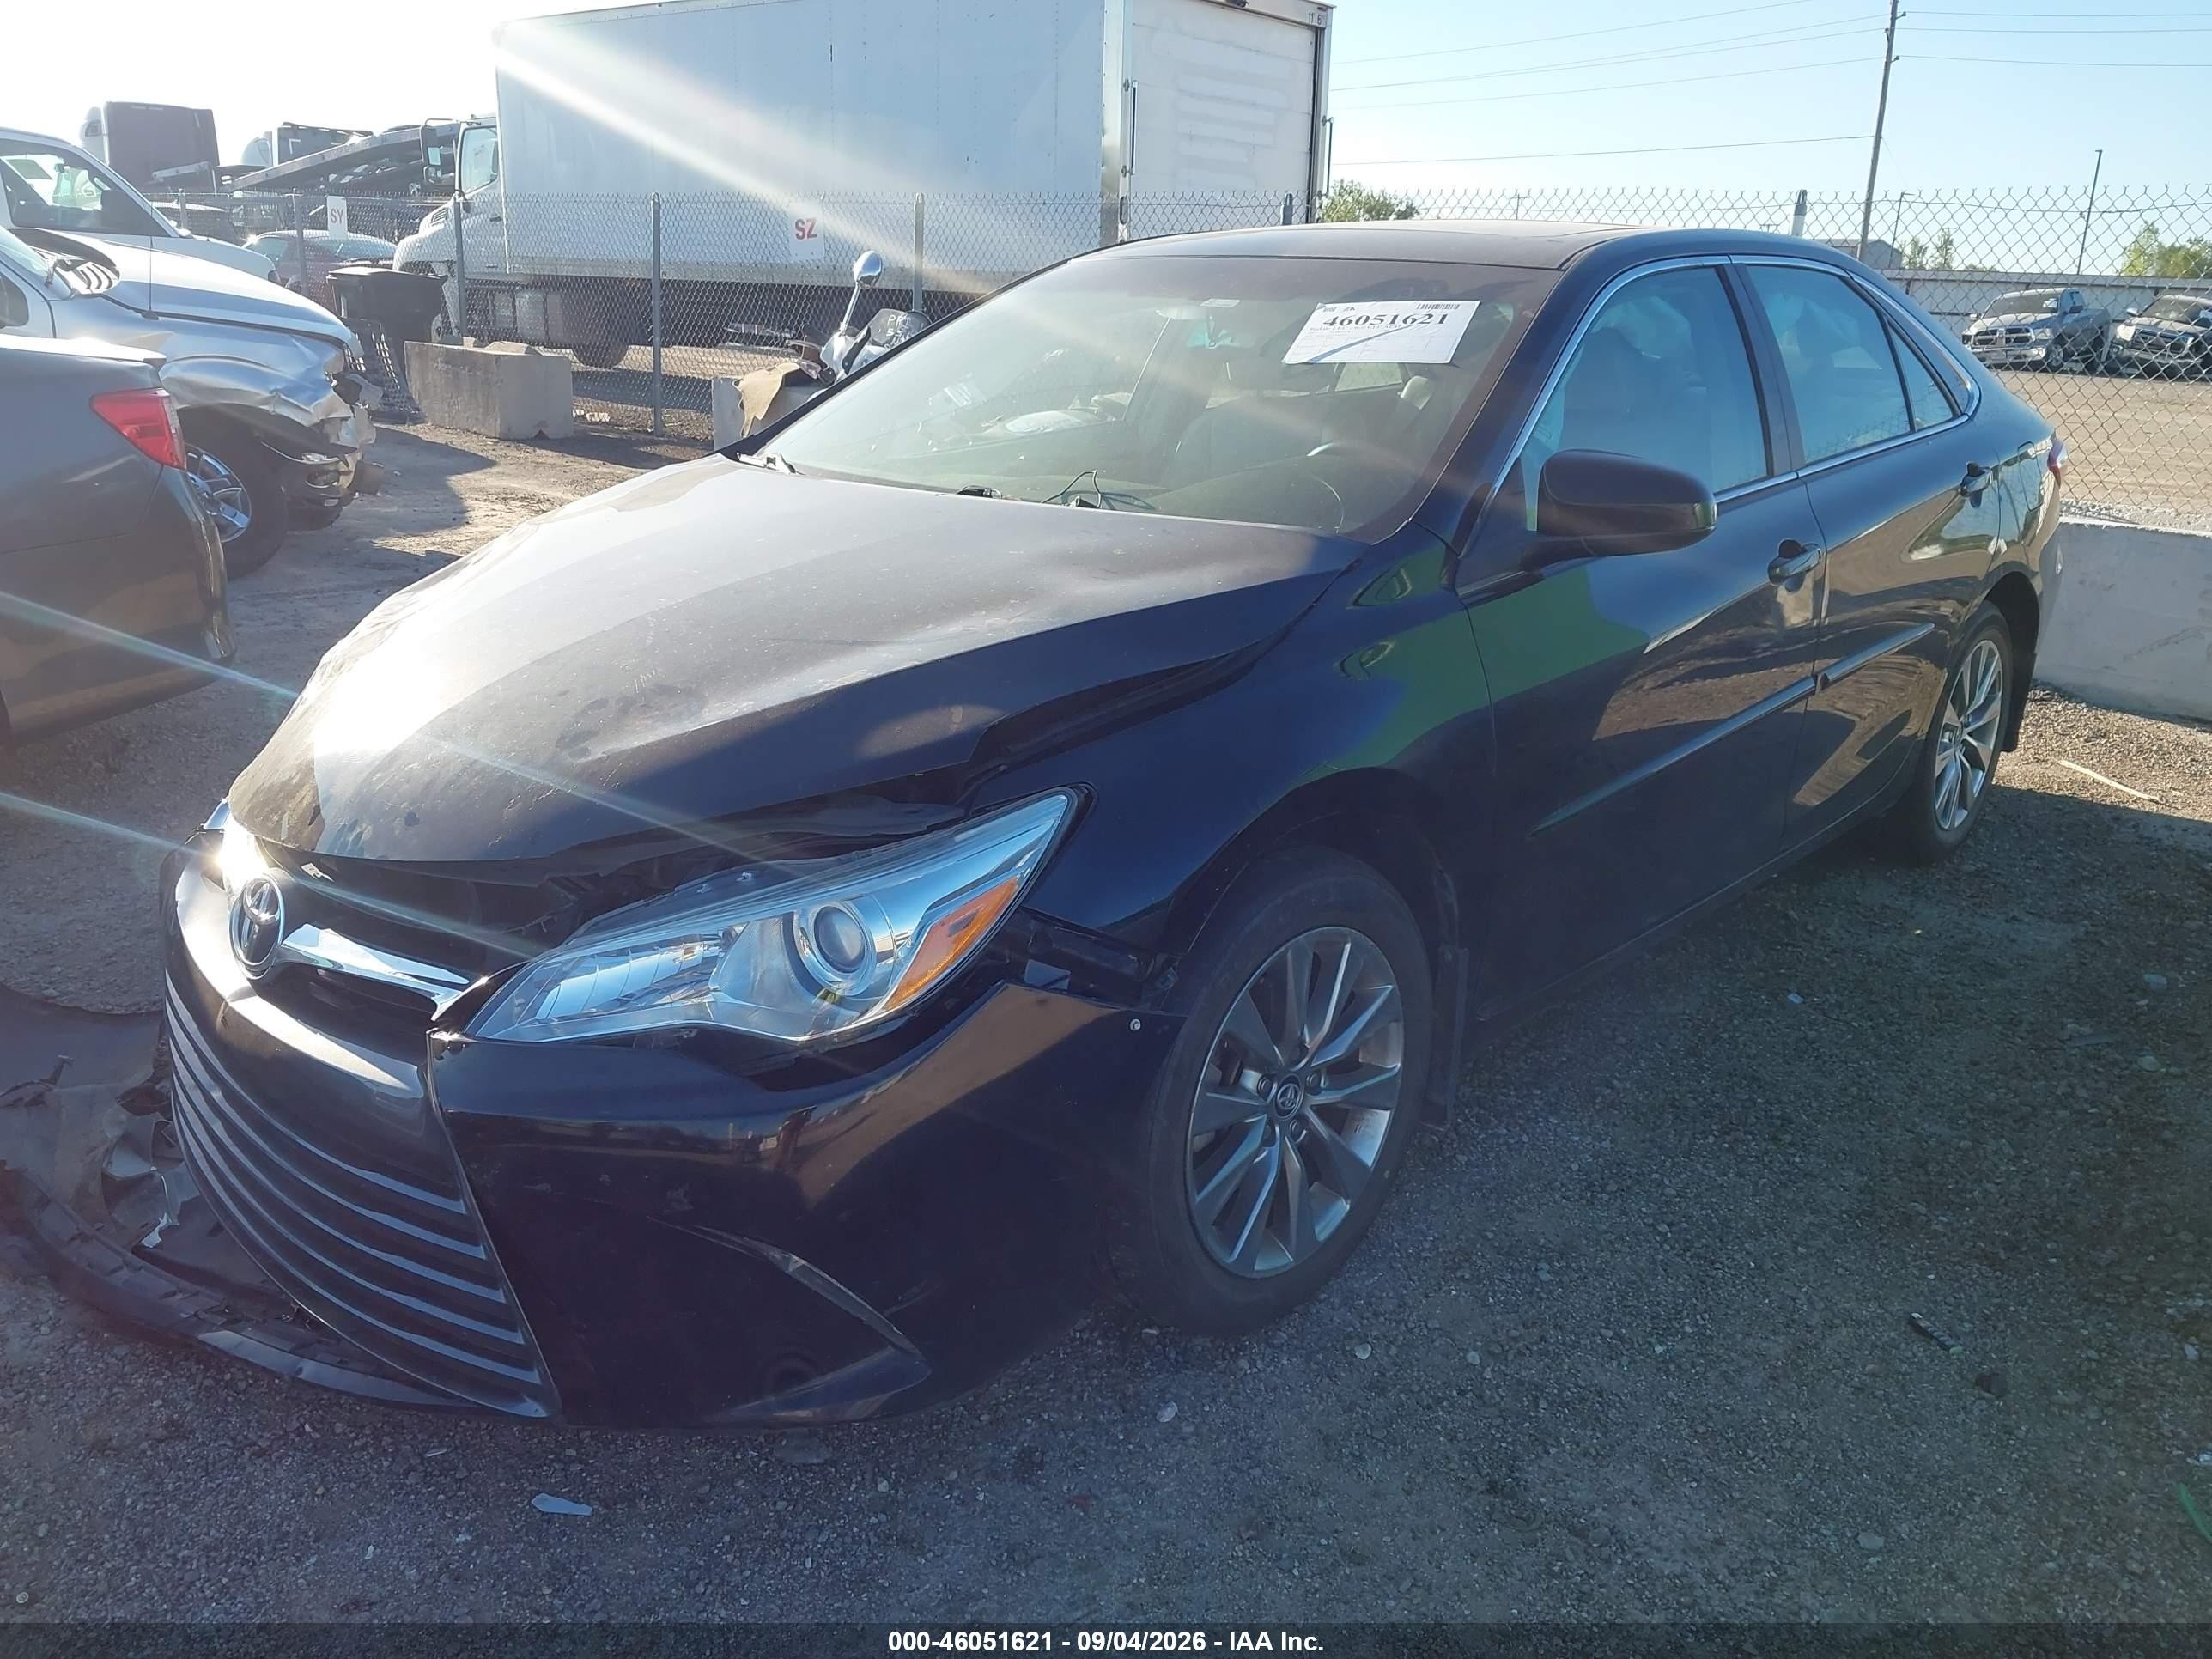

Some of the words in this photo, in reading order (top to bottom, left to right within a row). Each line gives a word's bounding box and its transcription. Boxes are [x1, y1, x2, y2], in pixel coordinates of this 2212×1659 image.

[331, 208, 343, 224] SY
[794, 217, 817, 240] SZ
[1323, 313, 1449, 326] 46051621
